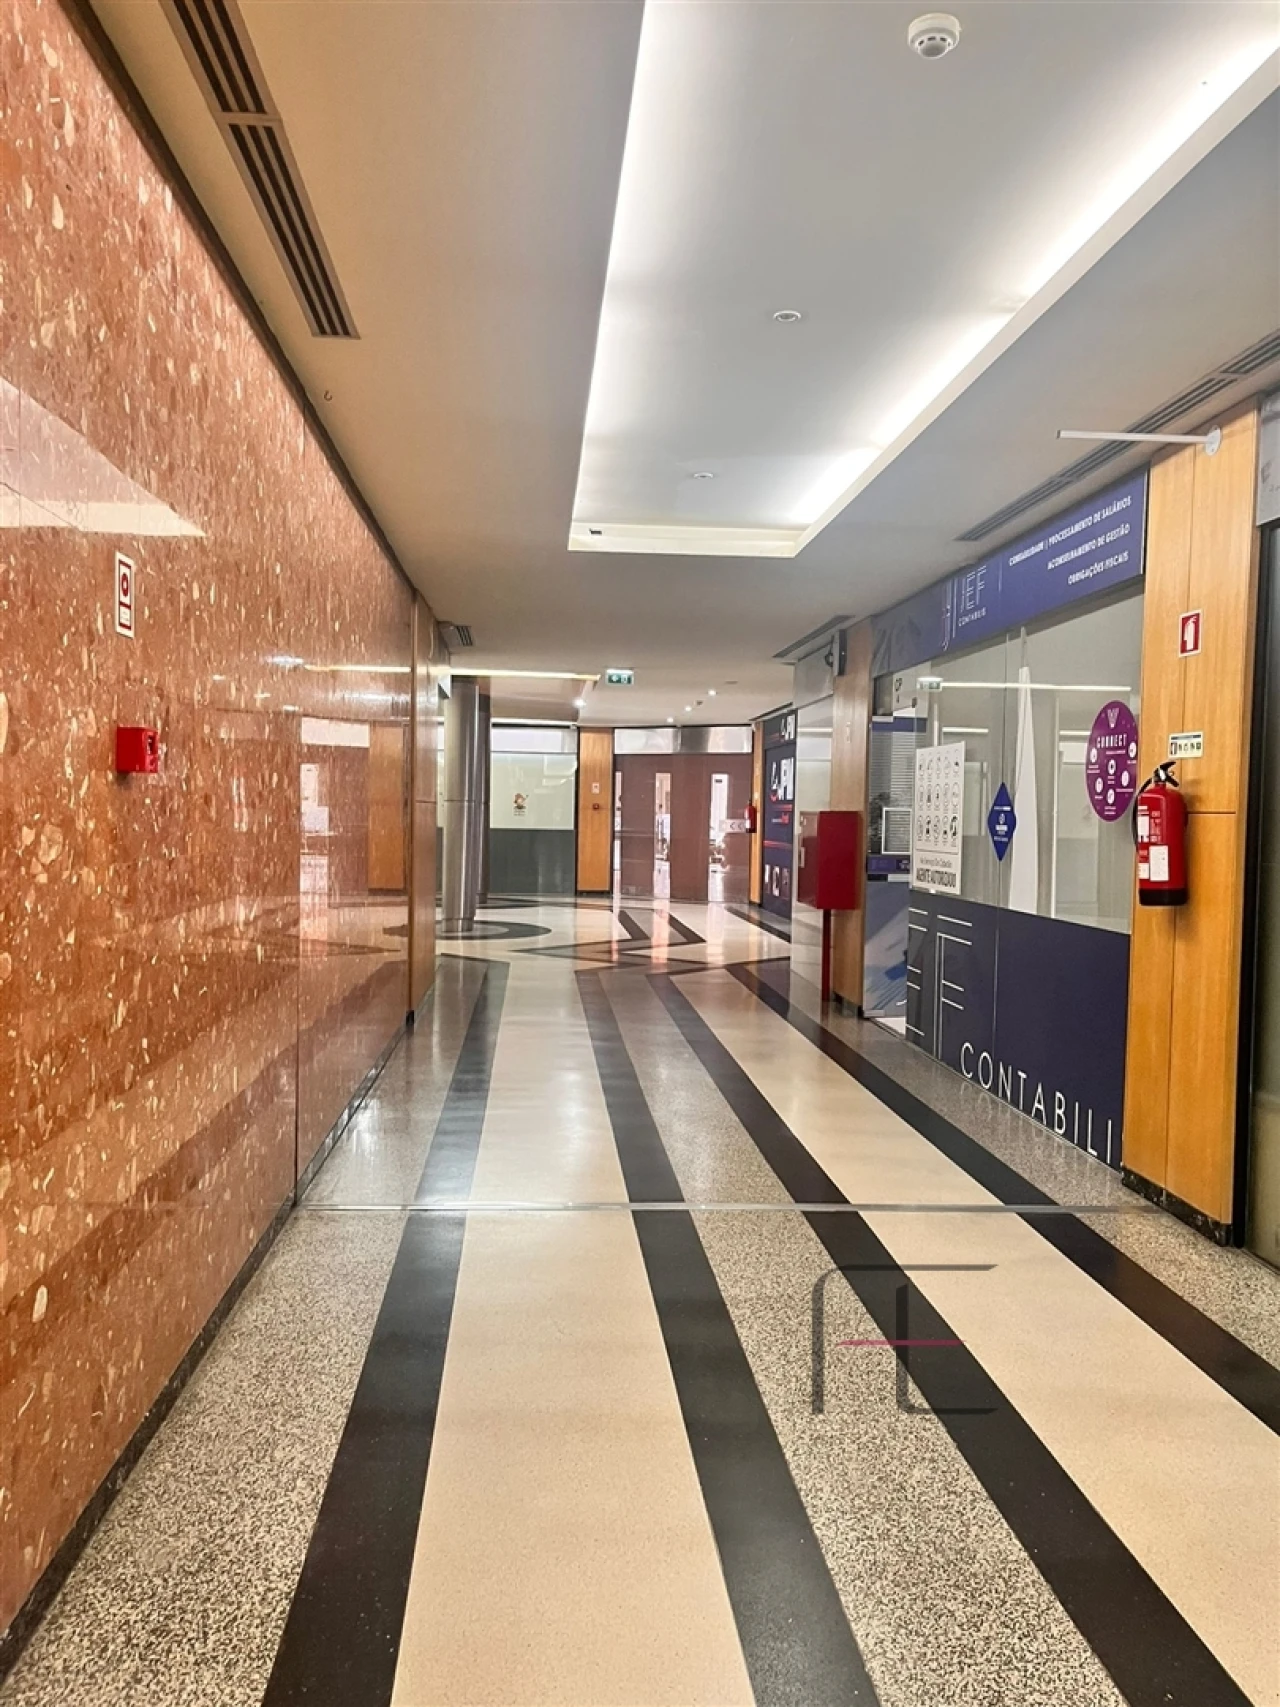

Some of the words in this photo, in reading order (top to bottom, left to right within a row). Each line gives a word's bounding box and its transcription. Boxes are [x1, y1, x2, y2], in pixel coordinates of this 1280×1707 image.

[1048, 516, 1093, 547] PROCESSAMENTO
[1093, 511, 1101, 524] DE
[1097, 534, 1106, 548] DE
[1105, 522, 1130, 543] GESTÃO
